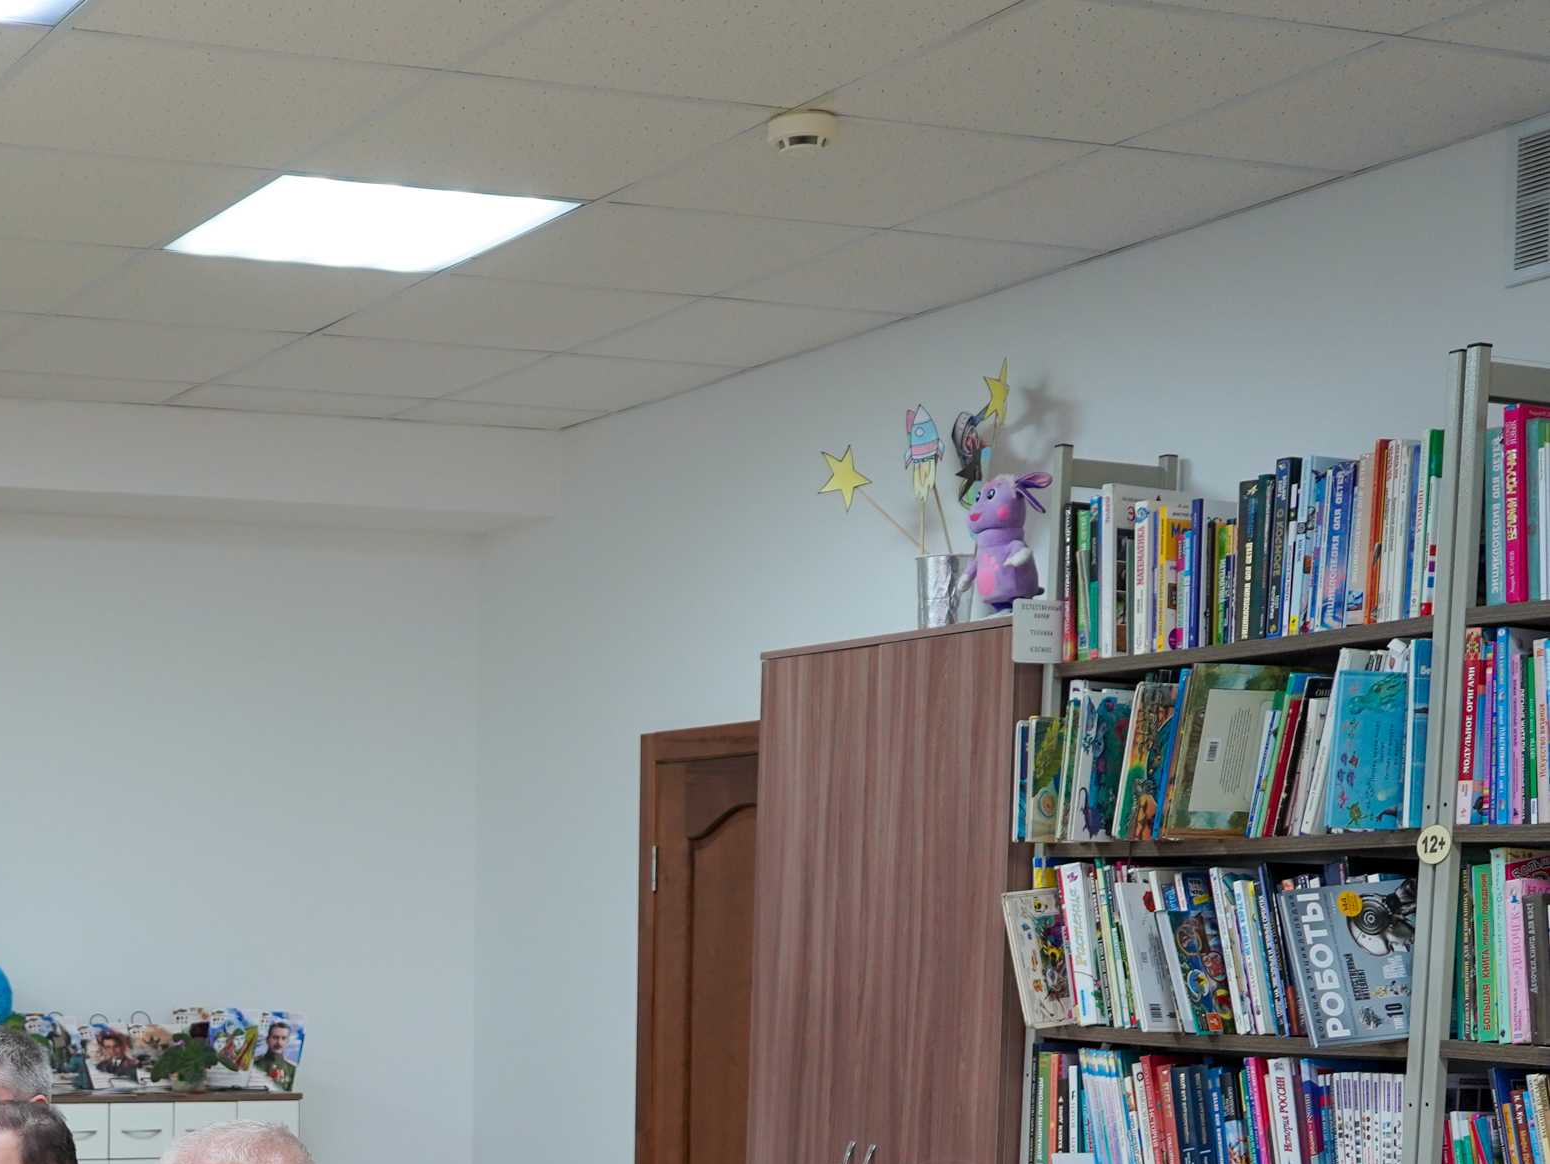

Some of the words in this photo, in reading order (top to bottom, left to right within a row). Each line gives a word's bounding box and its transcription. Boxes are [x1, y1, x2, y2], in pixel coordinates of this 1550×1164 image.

[1491, 438, 1501, 471] ДЕТЕЙ
[1506, 449, 1518, 494] МОГУЧИЙ
[1334, 470, 1345, 505] ДЕТЕЙ
[1491, 476, 1501, 499] ДЛЯ
[1277, 508, 1285, 518] О
[1333, 509, 1342, 531] ДЛЯ
[1351, 512, 1363, 584] ЭНЦИКЛОПЕДИЯ
[1358, 459, 1367, 487] ДЕТЕЙ
[1506, 498, 1518, 541] ВЕЛИКИЙ
[1136, 525, 1145, 586] МАТЕМАТИКА
[1245, 542, 1254, 564] ДЕТЕЙ
[1273, 521, 1284, 577] КОСМОСЕ
[1491, 503, 1502, 594] ЭНЦИКЛОПЕДИЯ
[1321, 535, 1340, 626] ЭНЦИКЛОПЕДИЯ
[1241, 582, 1252, 639] ЭНЦИКЛОПЕДИЯ
[1464, 666, 1476, 713] ОРИГАМИ
[1539, 703, 1547, 735] вязания
[1462, 715, 1474, 774] МОДУЛЬНОЕ
[1422, 835, 1446, 854] 12+
[1088, 872, 1096, 893] книга
[1481, 873, 1489, 915] ПОВЕДЕНИЯ
[1091, 895, 1100, 922] красная
[1236, 892, 1247, 923] КОРАБЛЯ
[1258, 894, 1270, 923] ОРБИТАХ
[1340, 897, 1349, 911] 144
[1070, 888, 1088, 966] Растения
[1242, 924, 1251, 956] ИСТОРИЯ
[1289, 894, 1312, 981] ЭНЦИКЛОПЕДИЯ
[1482, 918, 1490, 946] ПРАВИЛ
[1511, 911, 1523, 970] ДЕВОЧЕК
[1296, 892, 1352, 1038] РОБОТЫ
[1481, 949, 1490, 978] КНИГА
[1356, 968, 1371, 1000] ИНТЕЛЛЕКТ
[1309, 987, 1325, 1039] БОЛЬШАЯ
[1384, 1003, 1405, 1030] ТОП-10
[1482, 984, 1492, 1031] БОЛЬШАЯ
[1212, 1091, 1220, 1111] ДЕТЕЙ
[1275, 1076, 1288, 1114] РОССИИ
[1149, 1108, 1159, 1147] ИСТОРИЯ
[1282, 1115, 1294, 1152] История
